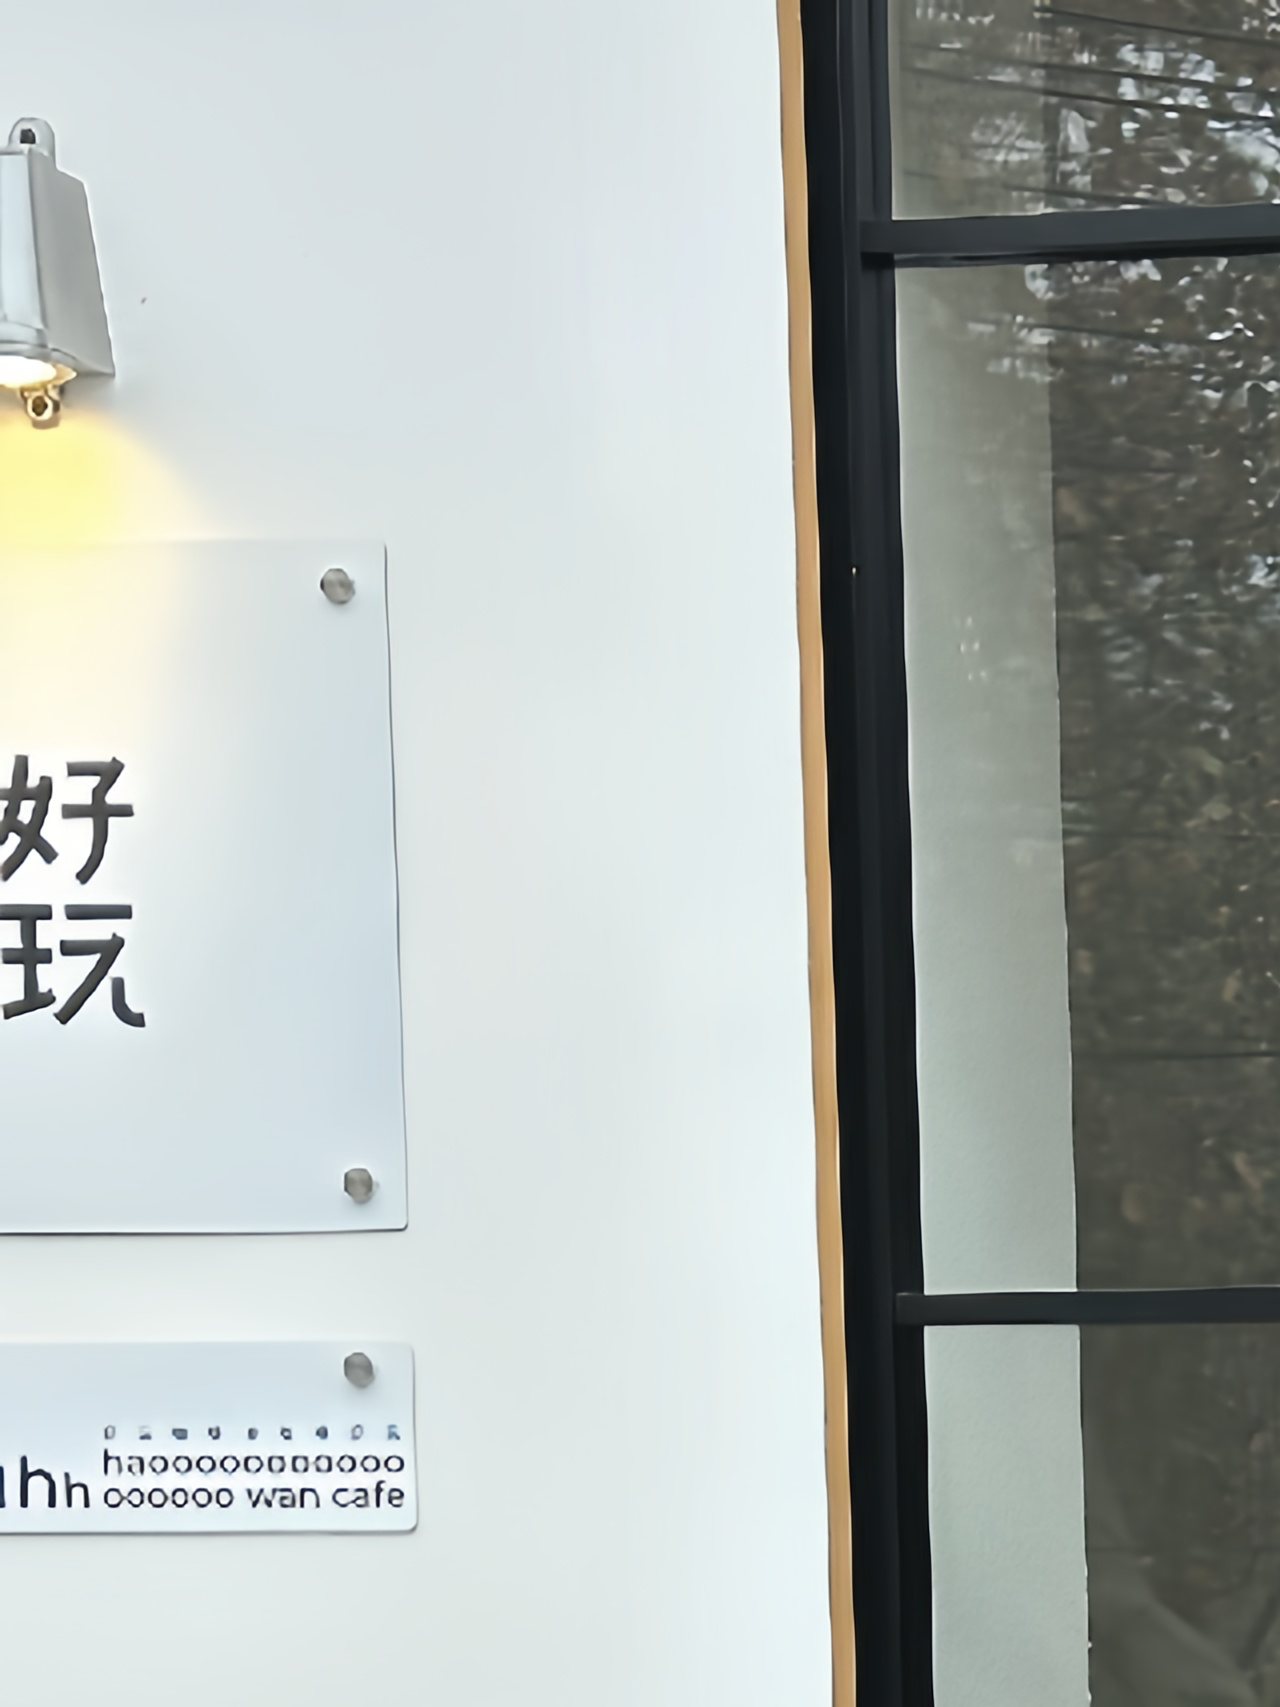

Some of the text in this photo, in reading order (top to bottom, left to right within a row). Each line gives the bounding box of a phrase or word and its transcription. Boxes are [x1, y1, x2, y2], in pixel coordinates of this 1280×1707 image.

[0, 755, 134, 885] 好
[0, 903, 146, 1028] 玩
[246, 1487, 320, 1508] wan
[332, 1480, 405, 1508] cafe
